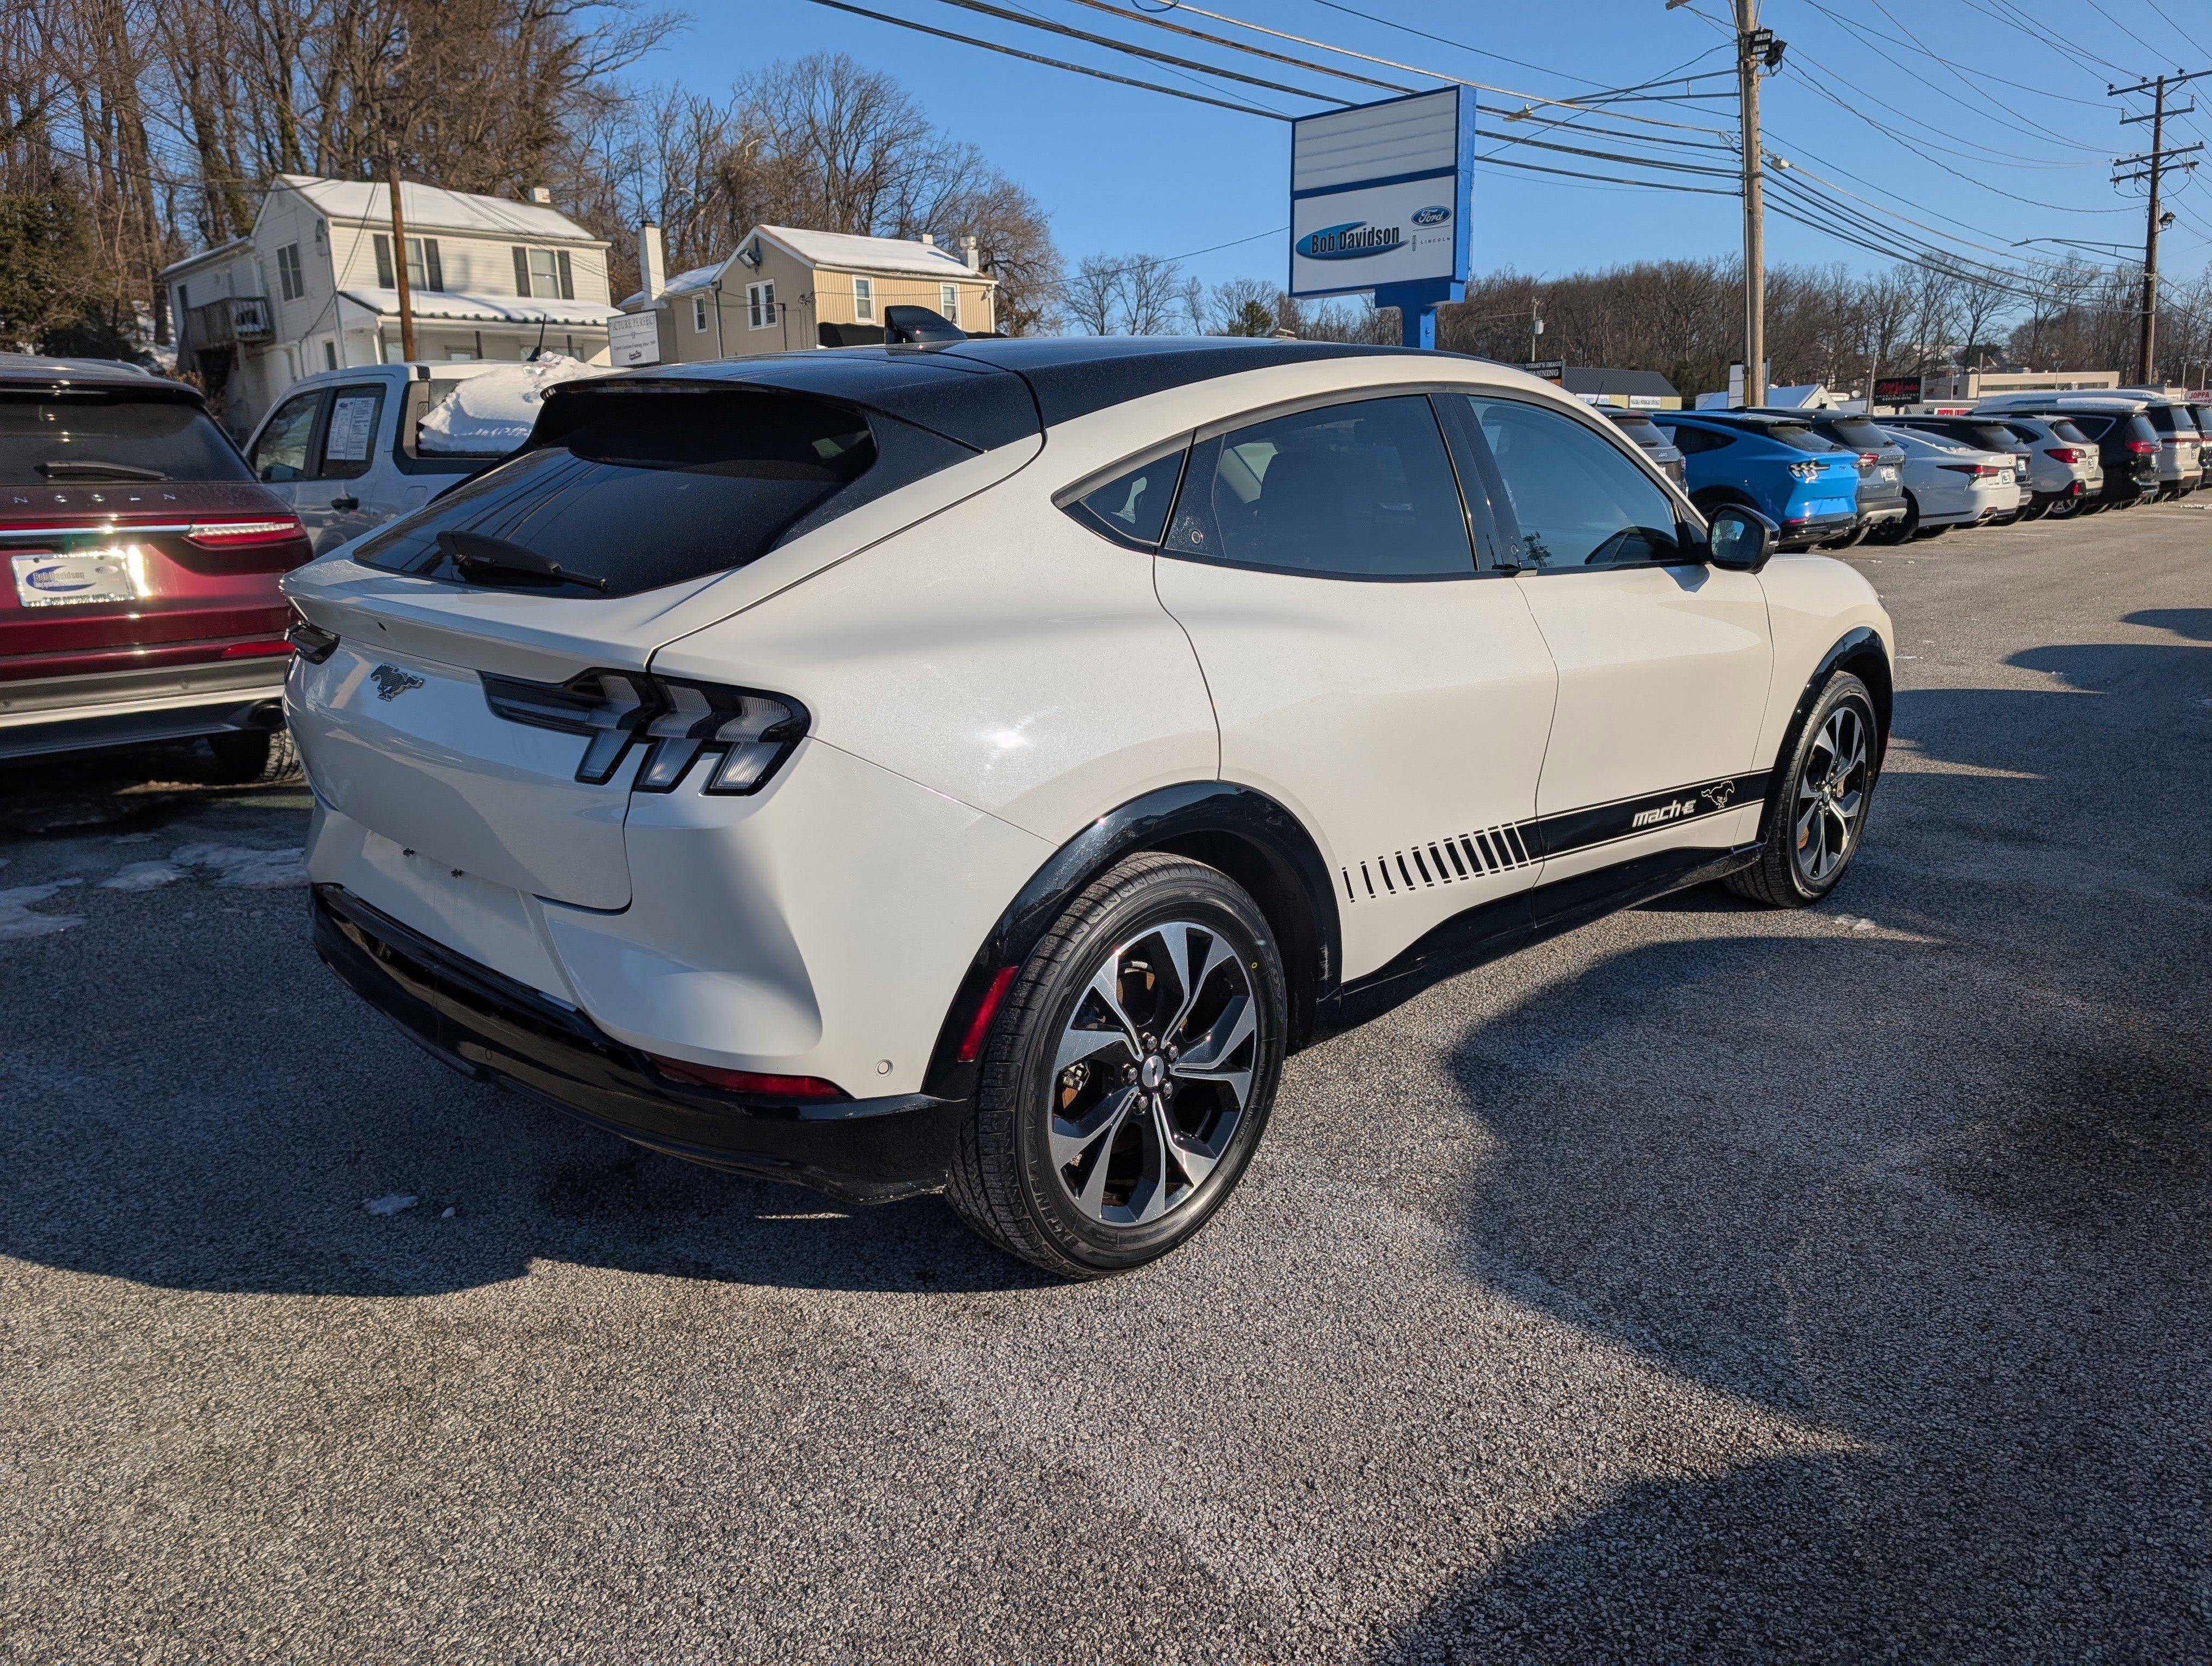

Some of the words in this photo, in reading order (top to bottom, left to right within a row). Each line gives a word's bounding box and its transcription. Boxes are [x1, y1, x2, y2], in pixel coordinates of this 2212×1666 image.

[1311, 233, 1335, 254] Bob
[1339, 226, 1400, 251] Davidson
[609, 319, 632, 331] PICTURE
[632, 315, 655, 327] PERFECT
[33, 572, 49, 582] Bob
[49, 571, 85, 581] Davidson
[1267, 950, 1284, 1024] TOYO
[1026, 1159, 1081, 1250] EXTENSA
